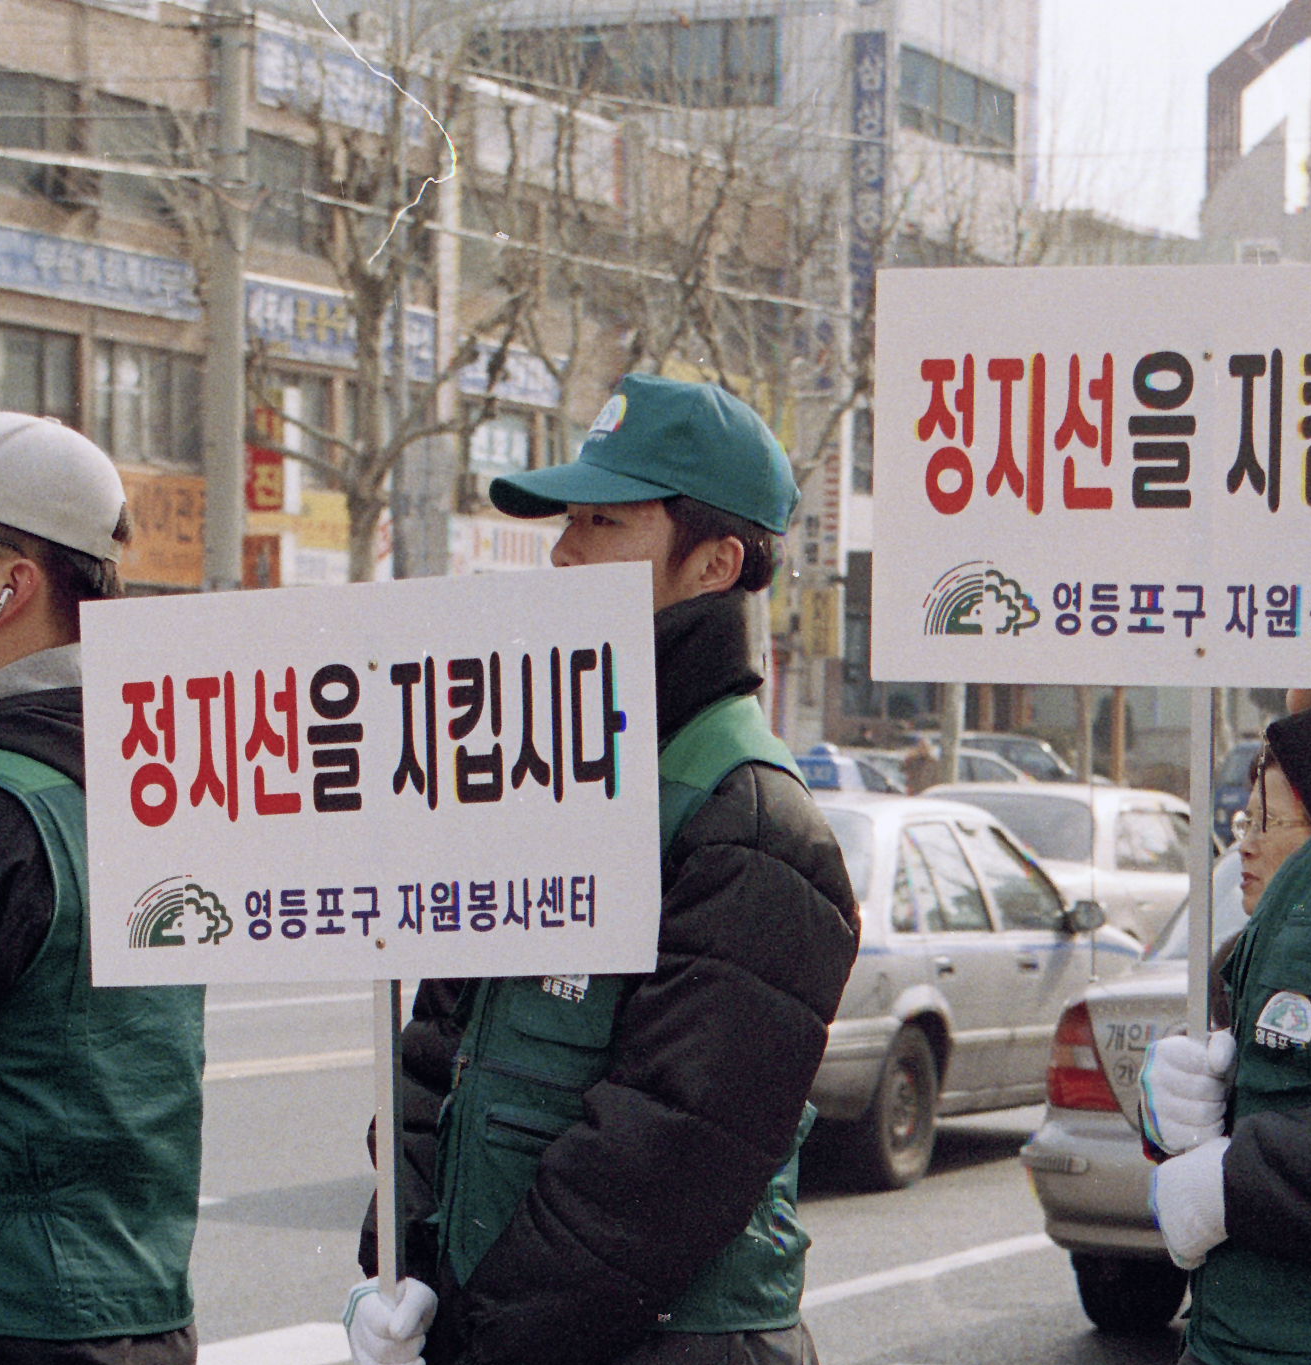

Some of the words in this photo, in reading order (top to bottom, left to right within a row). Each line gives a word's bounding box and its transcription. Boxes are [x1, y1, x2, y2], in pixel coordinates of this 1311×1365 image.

[915, 350, 1197, 516] 정지선을
[1052, 581, 1207, 638] 영등포구
[121, 662, 365, 828] 정지선을
[390, 641, 627, 812] 지킵시다
[244, 886, 381, 941] 영등포구
[396, 874, 596, 936] 자원봉사센터
[542, 976, 586, 1004] 영등포구
